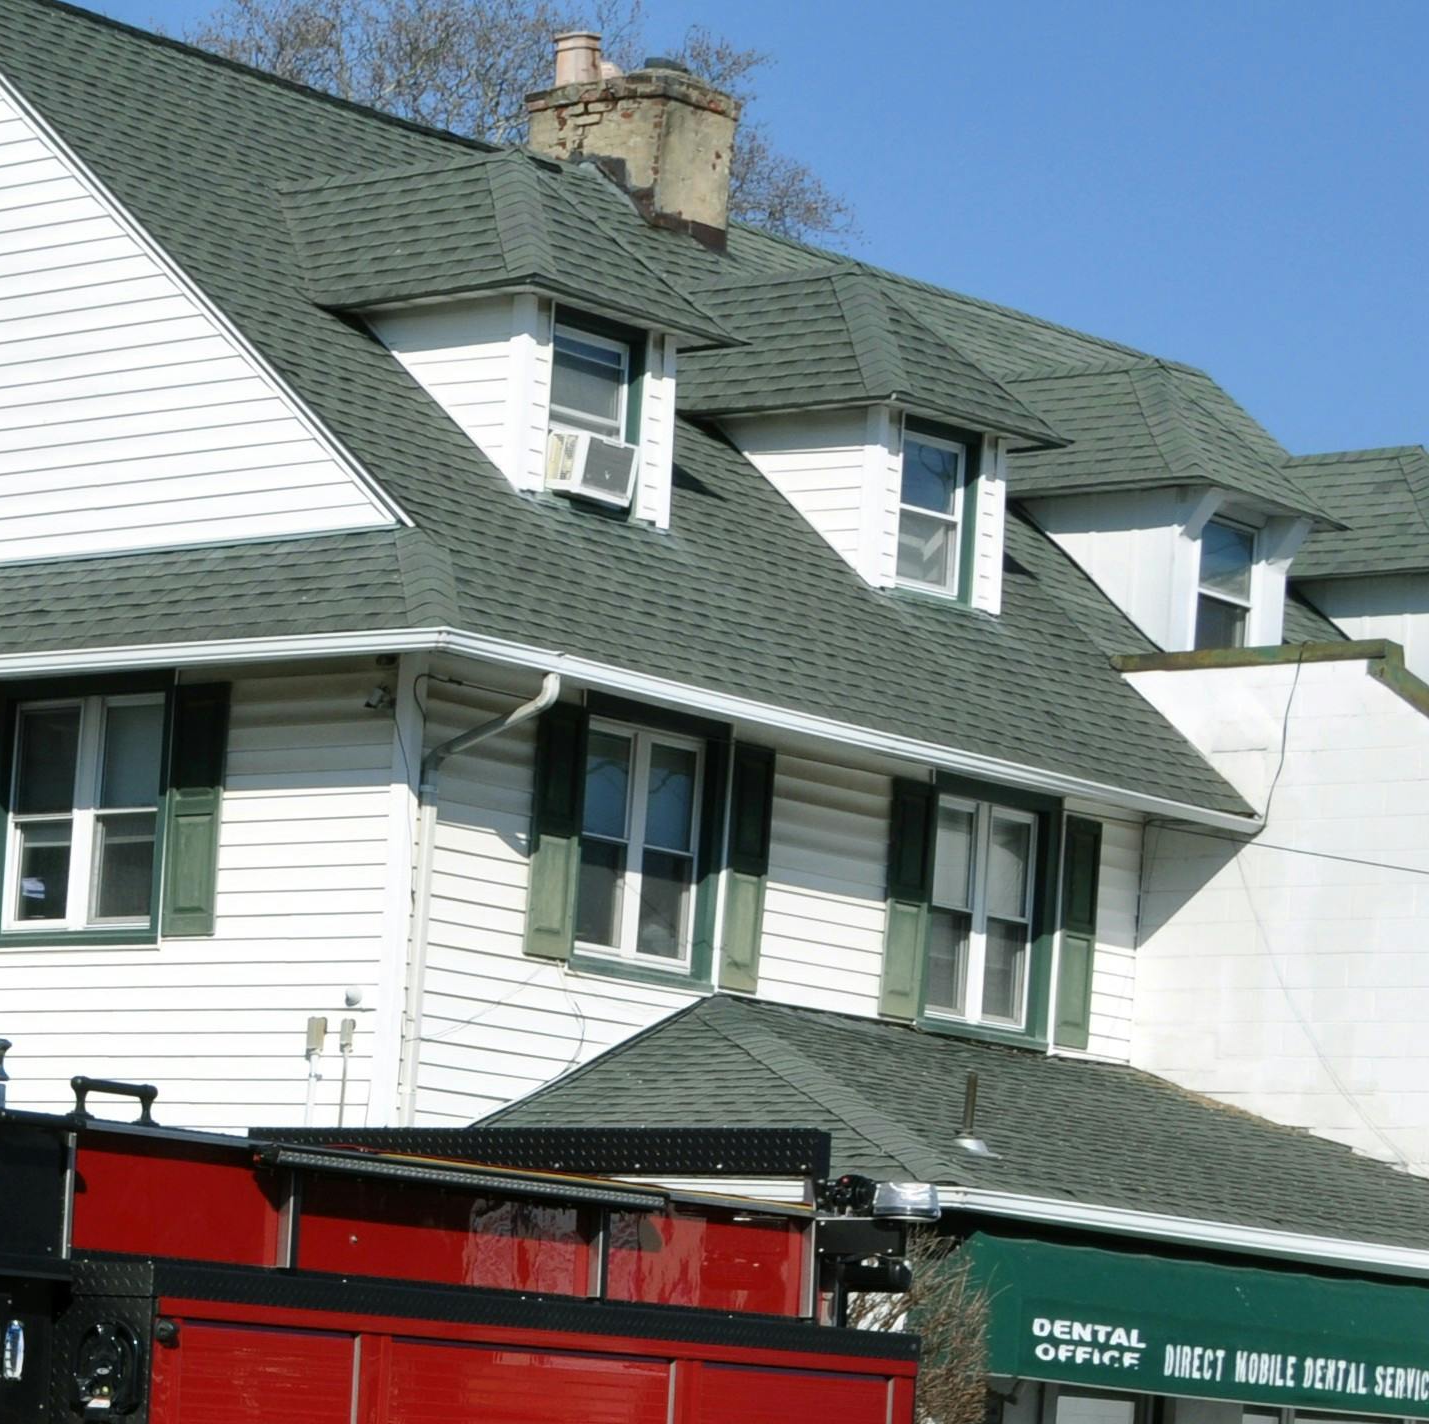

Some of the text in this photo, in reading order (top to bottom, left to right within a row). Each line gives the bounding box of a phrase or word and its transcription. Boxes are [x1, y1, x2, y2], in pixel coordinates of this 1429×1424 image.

[1031, 1317, 1148, 1350] DENTAL
[1034, 1342, 1141, 1370] OFFICE
[1162, 1344, 1226, 1382] DIRECT
[1234, 1350, 1297, 1388] MOBILE
[1302, 1356, 1368, 1396] DENTAL
